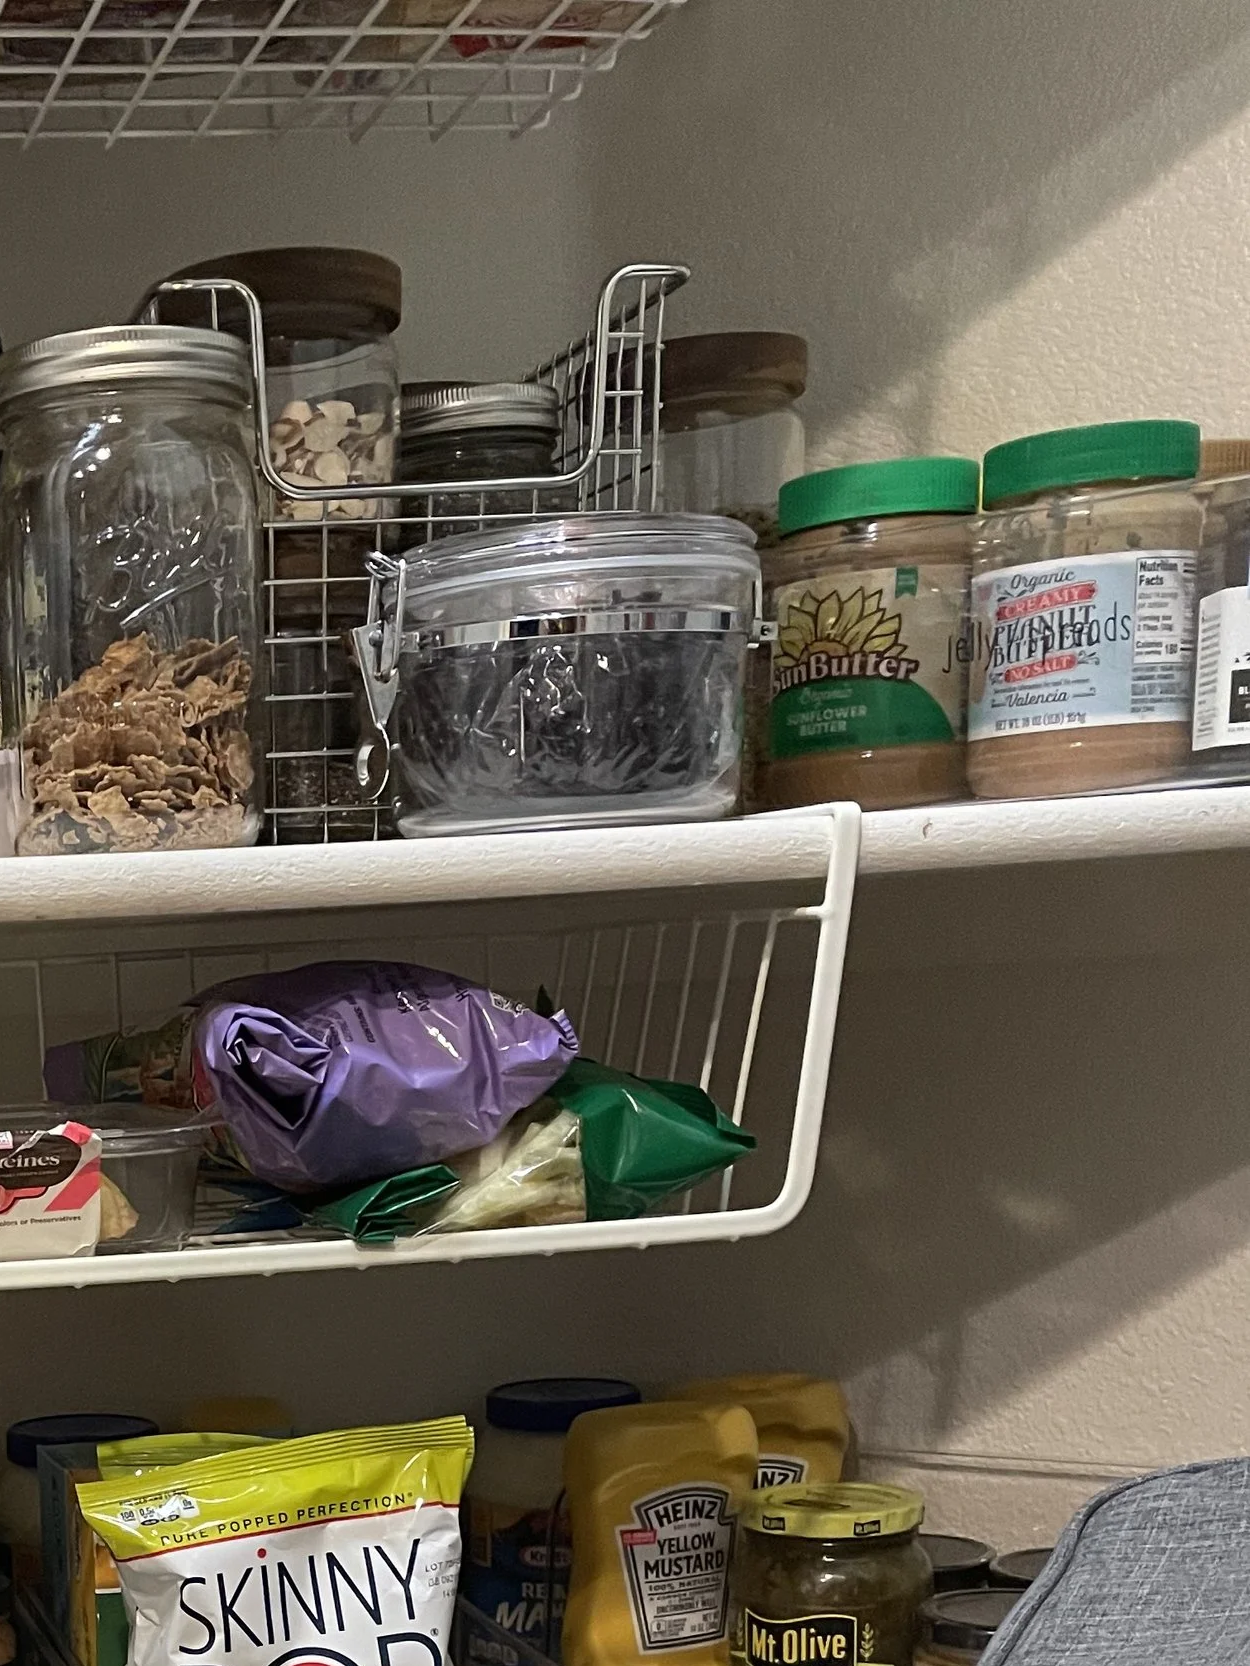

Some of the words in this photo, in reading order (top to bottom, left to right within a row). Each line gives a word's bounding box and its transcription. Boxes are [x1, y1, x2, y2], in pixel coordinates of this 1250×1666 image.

[1138, 560, 1179, 573] Nutrition
[1010, 567, 1076, 594] Organic
[1138, 574, 1164, 587] Facts
[1004, 586, 1081, 618] CREAMY
[772, 651, 919, 696] SunButter
[1010, 666, 1030, 680] NO
[1034, 655, 1072, 676] SALT
[1006, 690, 1069, 708] Valencia
[799, 720, 847, 737] BUTTER
[30, 1215, 82, 1225] Preservatives
[217, 1512, 289, 1536] POPPED
[296, 1495, 407, 1521] PERFECTION
[654, 1499, 718, 1528] HEINZ
[657, 1531, 716, 1556] YELLOW
[644, 1549, 725, 1580] MUSTARD
[179, 1537, 420, 1658] SKINNY
[751, 1624, 780, 1664] Mt.
[782, 1628, 847, 1665] Olive
